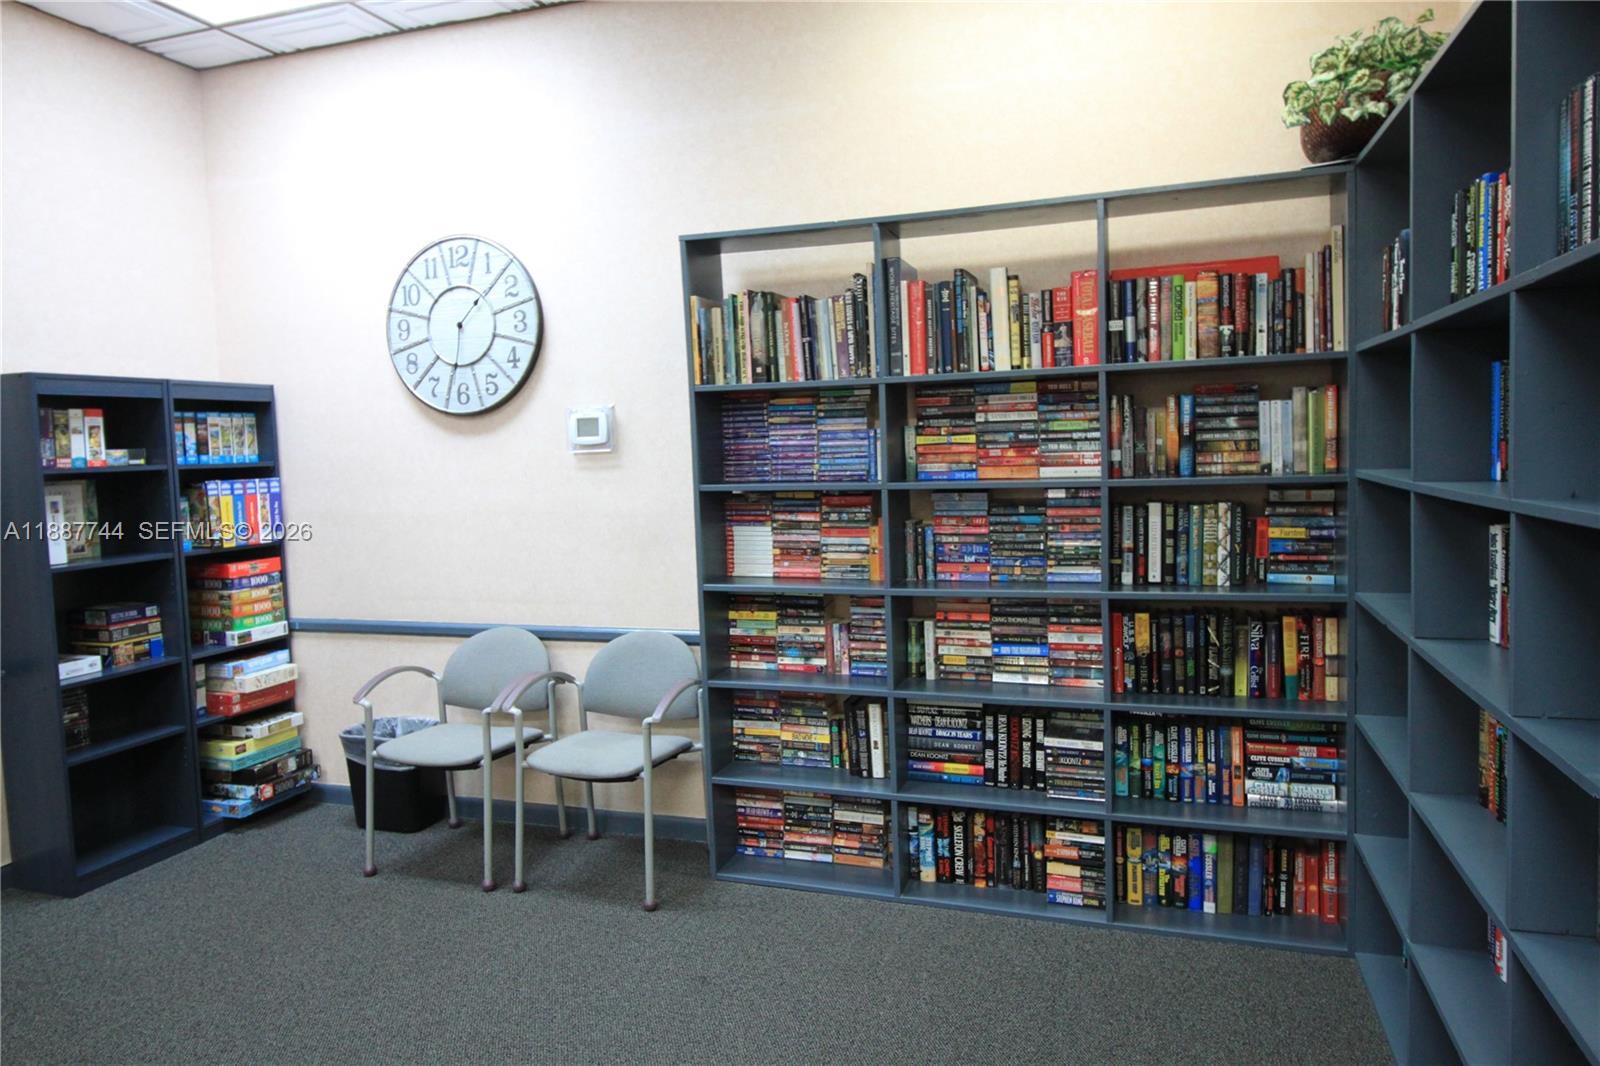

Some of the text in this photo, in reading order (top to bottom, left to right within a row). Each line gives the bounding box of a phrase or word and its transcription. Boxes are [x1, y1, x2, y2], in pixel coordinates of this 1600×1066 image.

[449, 245, 469, 268] 12
[485, 252, 492, 274] 1
[424, 258, 438, 279] 11
[402, 284, 420, 306] 10
[505, 275, 519, 297] 2
[1174, 285, 1182, 320] CROOKED
[398, 319, 410, 341] 9
[513, 310, 527, 332] 3
[406, 353, 418, 374] 8
[507, 346, 520, 368] 4
[429, 376, 440, 397] 7
[457, 383, 470, 404] 6
[485, 373, 499, 395] 5
[1203, 518, 1217, 544] STEELE
[250, 576, 268, 586] 1000
[254, 601, 271, 610] 1000
[1250, 624, 1264, 650] Silva
[1300, 635, 1309, 661] FIRE
[1250, 666, 1259, 688] Cellist
[998, 714, 1007, 733] DEAN
[998, 733, 1007, 759] KOONTZ
[1292, 785, 1329, 793] ATLANTIS
[954, 825, 965, 876] SKELETON CREW
